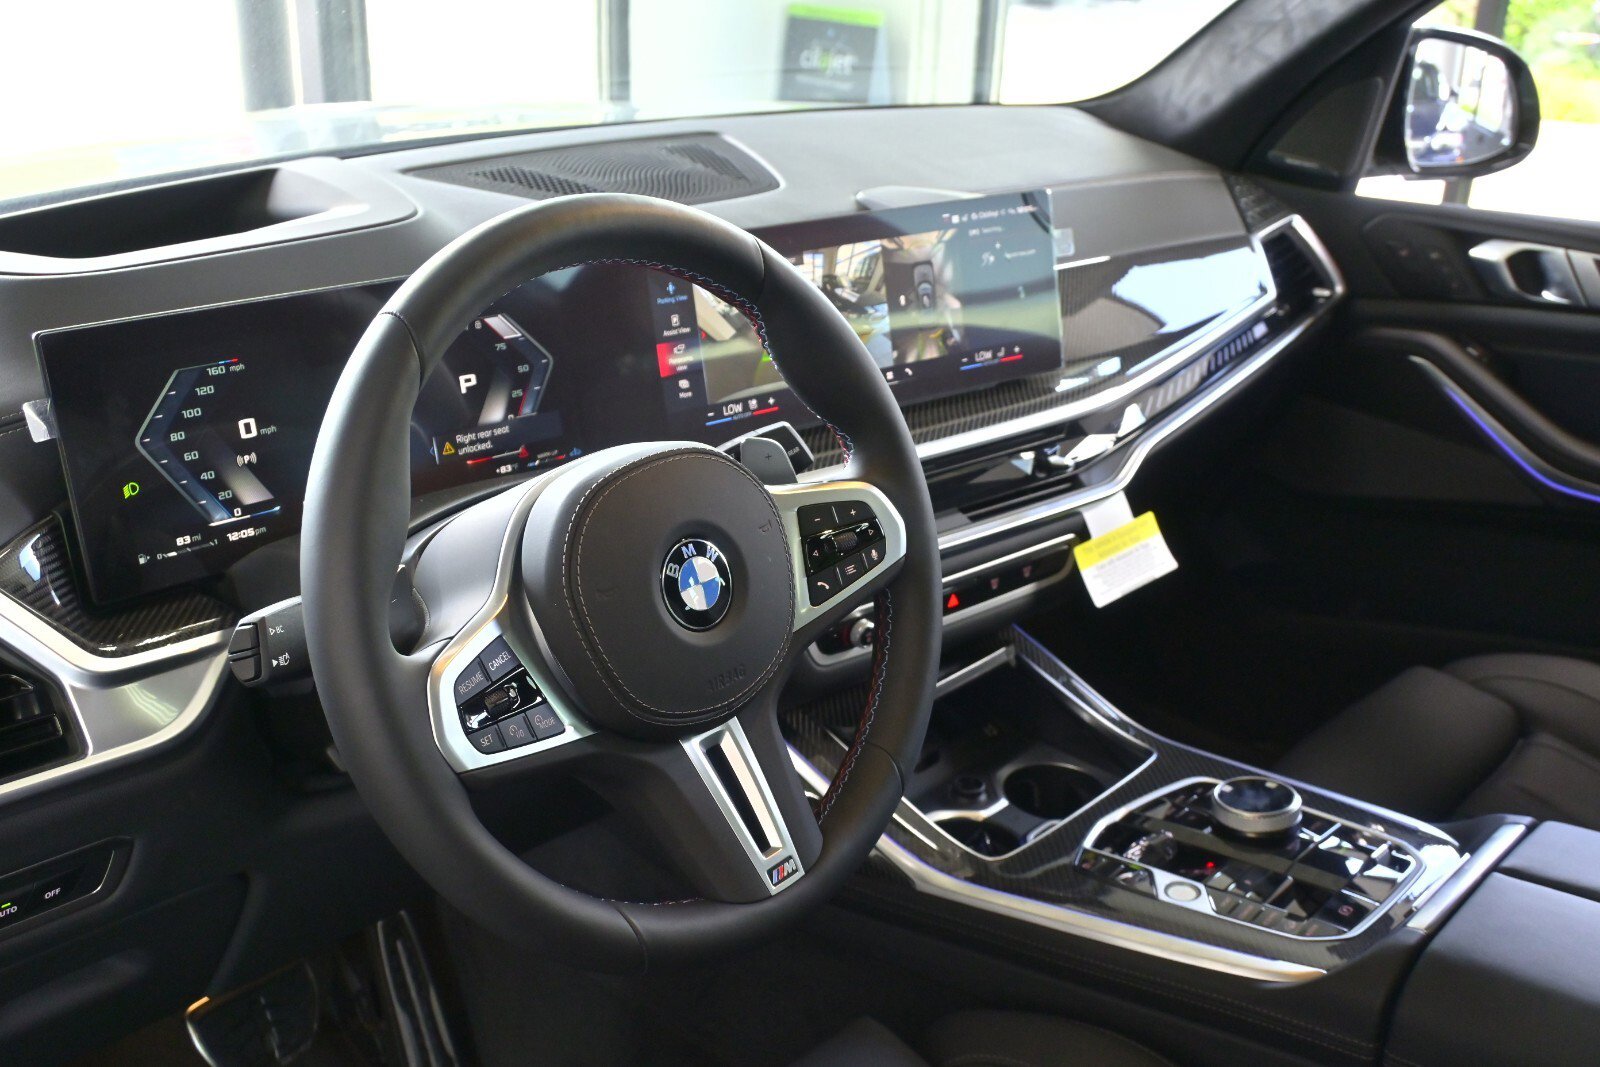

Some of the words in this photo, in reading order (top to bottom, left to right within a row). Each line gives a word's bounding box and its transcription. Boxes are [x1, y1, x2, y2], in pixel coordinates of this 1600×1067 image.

[495, 342, 507, 351] 75
[974, 350, 992, 362] LOW
[206, 365, 226, 376] 160
[229, 363, 245, 373] mph
[517, 364, 529, 373] 50
[458, 373, 477, 394] P
[195, 385, 215, 396] 120
[512, 389, 523, 398] 25
[181, 407, 202, 419] 100
[722, 402, 743, 417] LOW
[238, 418, 258, 439] 0
[260, 424, 277, 436] mph
[170, 431, 186, 442] 80
[455, 431, 476, 445] Right
[477, 429, 492, 439] rear
[493, 425, 510, 436] seat
[458, 441, 494, 456] unlocked.
[184, 451, 199, 461] 60
[200, 470, 216, 480] 40
[218, 490, 233, 500] 20
[233, 507, 242, 517] 0
[227, 528, 255, 542] 12:05
[255, 525, 267, 537] pm
[176, 534, 192, 546] 83
[666, 543, 719, 579] BMW
[276, 625, 285, 634] BC
[488, 650, 512, 671] CANCEL
[458, 671, 485, 695] RESUME
[480, 734, 493, 747] SET
[44, 887, 61, 899] OFF
